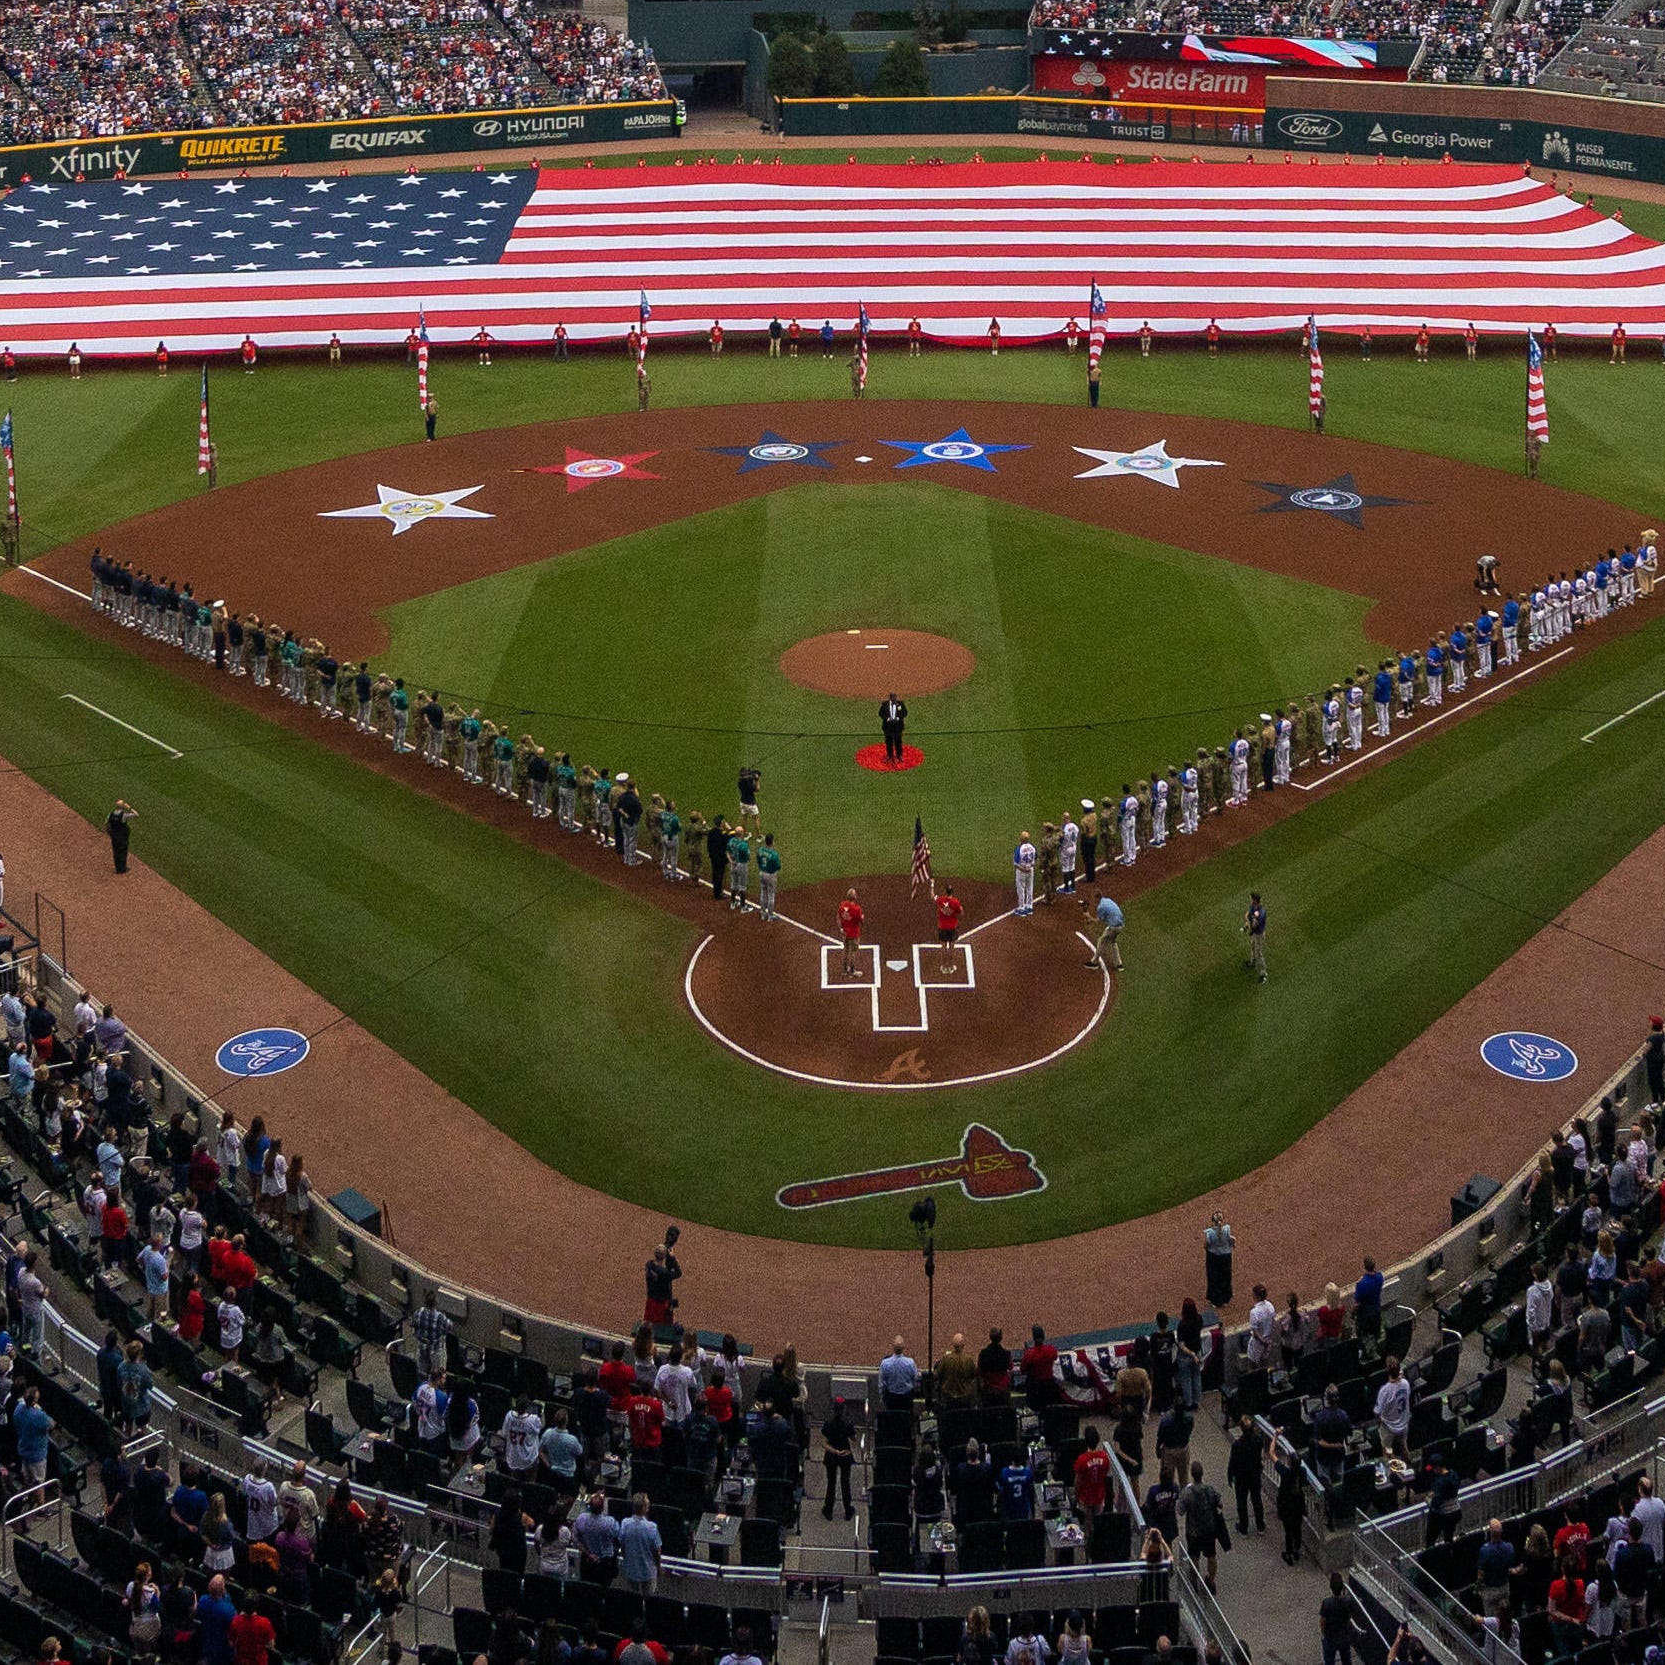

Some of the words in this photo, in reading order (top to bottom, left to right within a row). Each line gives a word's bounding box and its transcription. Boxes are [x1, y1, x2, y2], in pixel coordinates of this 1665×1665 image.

[507, 115, 584, 132] HYUNDAI
[1018, 118, 1088, 133] globalpayments
[1111, 125, 1150, 137] TRUIST
[1289, 116, 1331, 135] Ford
[180, 135, 286, 158] QUIKRETE
[329, 129, 428, 152] EQUIFAX
[1392, 130, 1446, 147] Georgia
[1450, 133, 1494, 149] Power
[1575, 142, 1604, 155] KAISER
[50, 144, 141, 180] xfinity
[1575, 155, 1633, 172] PERMANENTE
